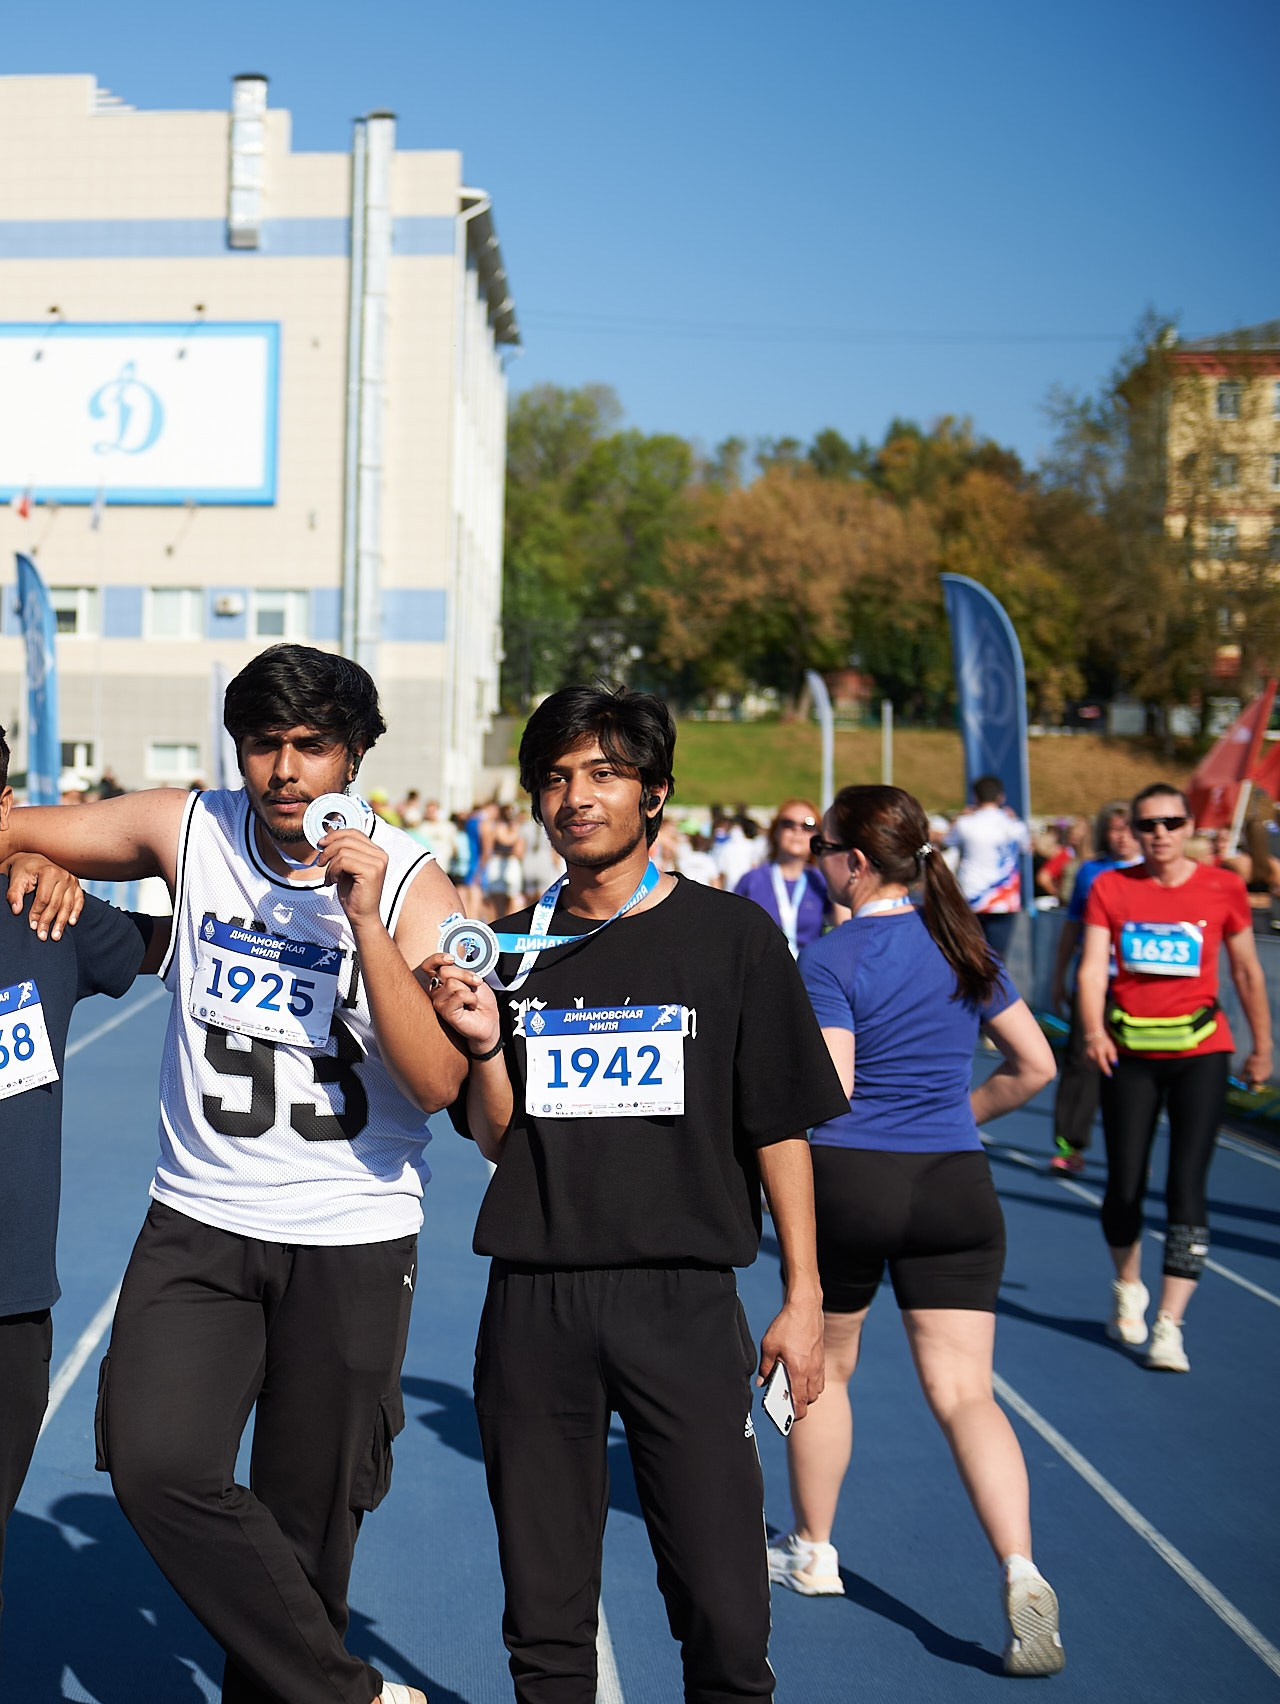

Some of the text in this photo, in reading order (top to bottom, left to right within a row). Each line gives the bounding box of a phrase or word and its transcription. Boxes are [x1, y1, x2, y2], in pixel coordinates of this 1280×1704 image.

[230, 930, 306, 955] ДИНАМОВСКАЯ
[251, 946, 280, 960] МИЛЯ
[1131, 937, 1190, 963] 1623
[206, 957, 316, 1017] 1925
[563, 1009, 643, 1023] ДИНАМОВСКАЯ
[588, 1021, 618, 1032] МИЛЯ
[202, 1014, 369, 1142] 93
[547, 1045, 663, 1088] 1942
